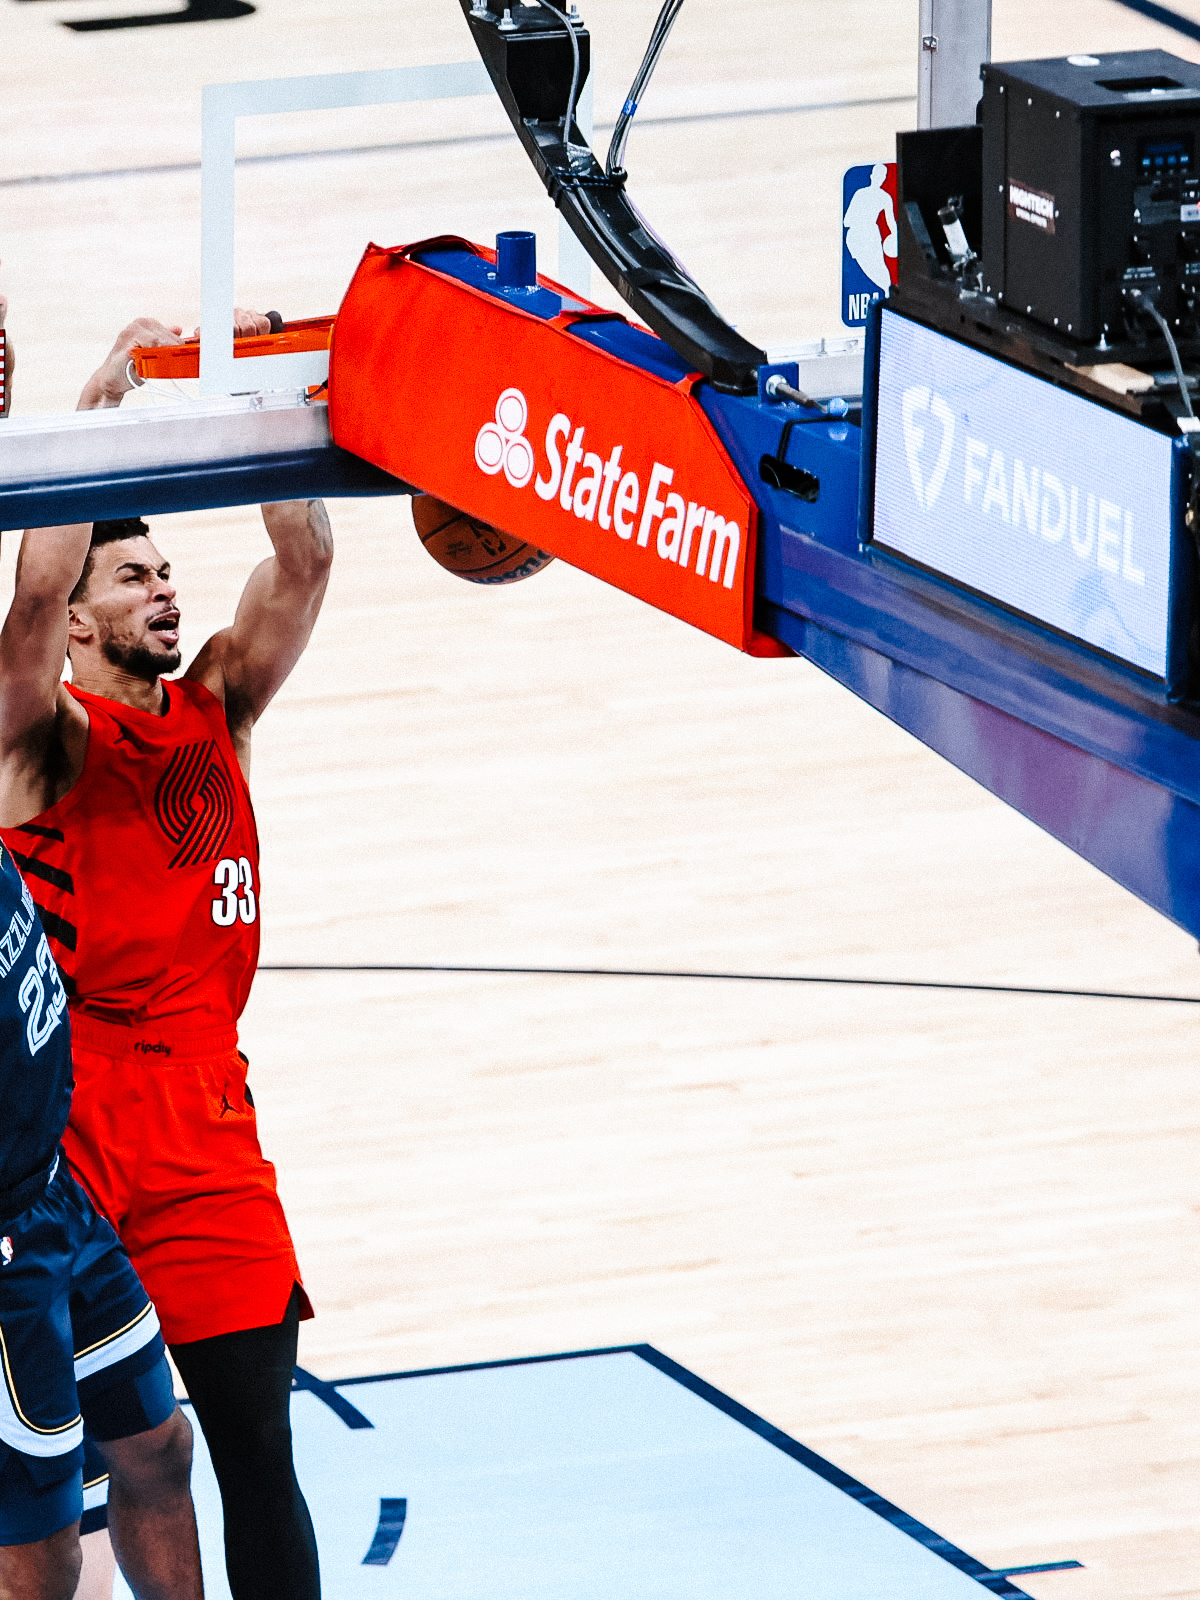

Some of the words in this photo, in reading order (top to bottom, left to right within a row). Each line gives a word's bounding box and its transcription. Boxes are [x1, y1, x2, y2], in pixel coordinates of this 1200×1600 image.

[963, 436, 1146, 586] FANDUEL
[211, 856, 257, 927] 33
[18, 931, 68, 1057] 23
